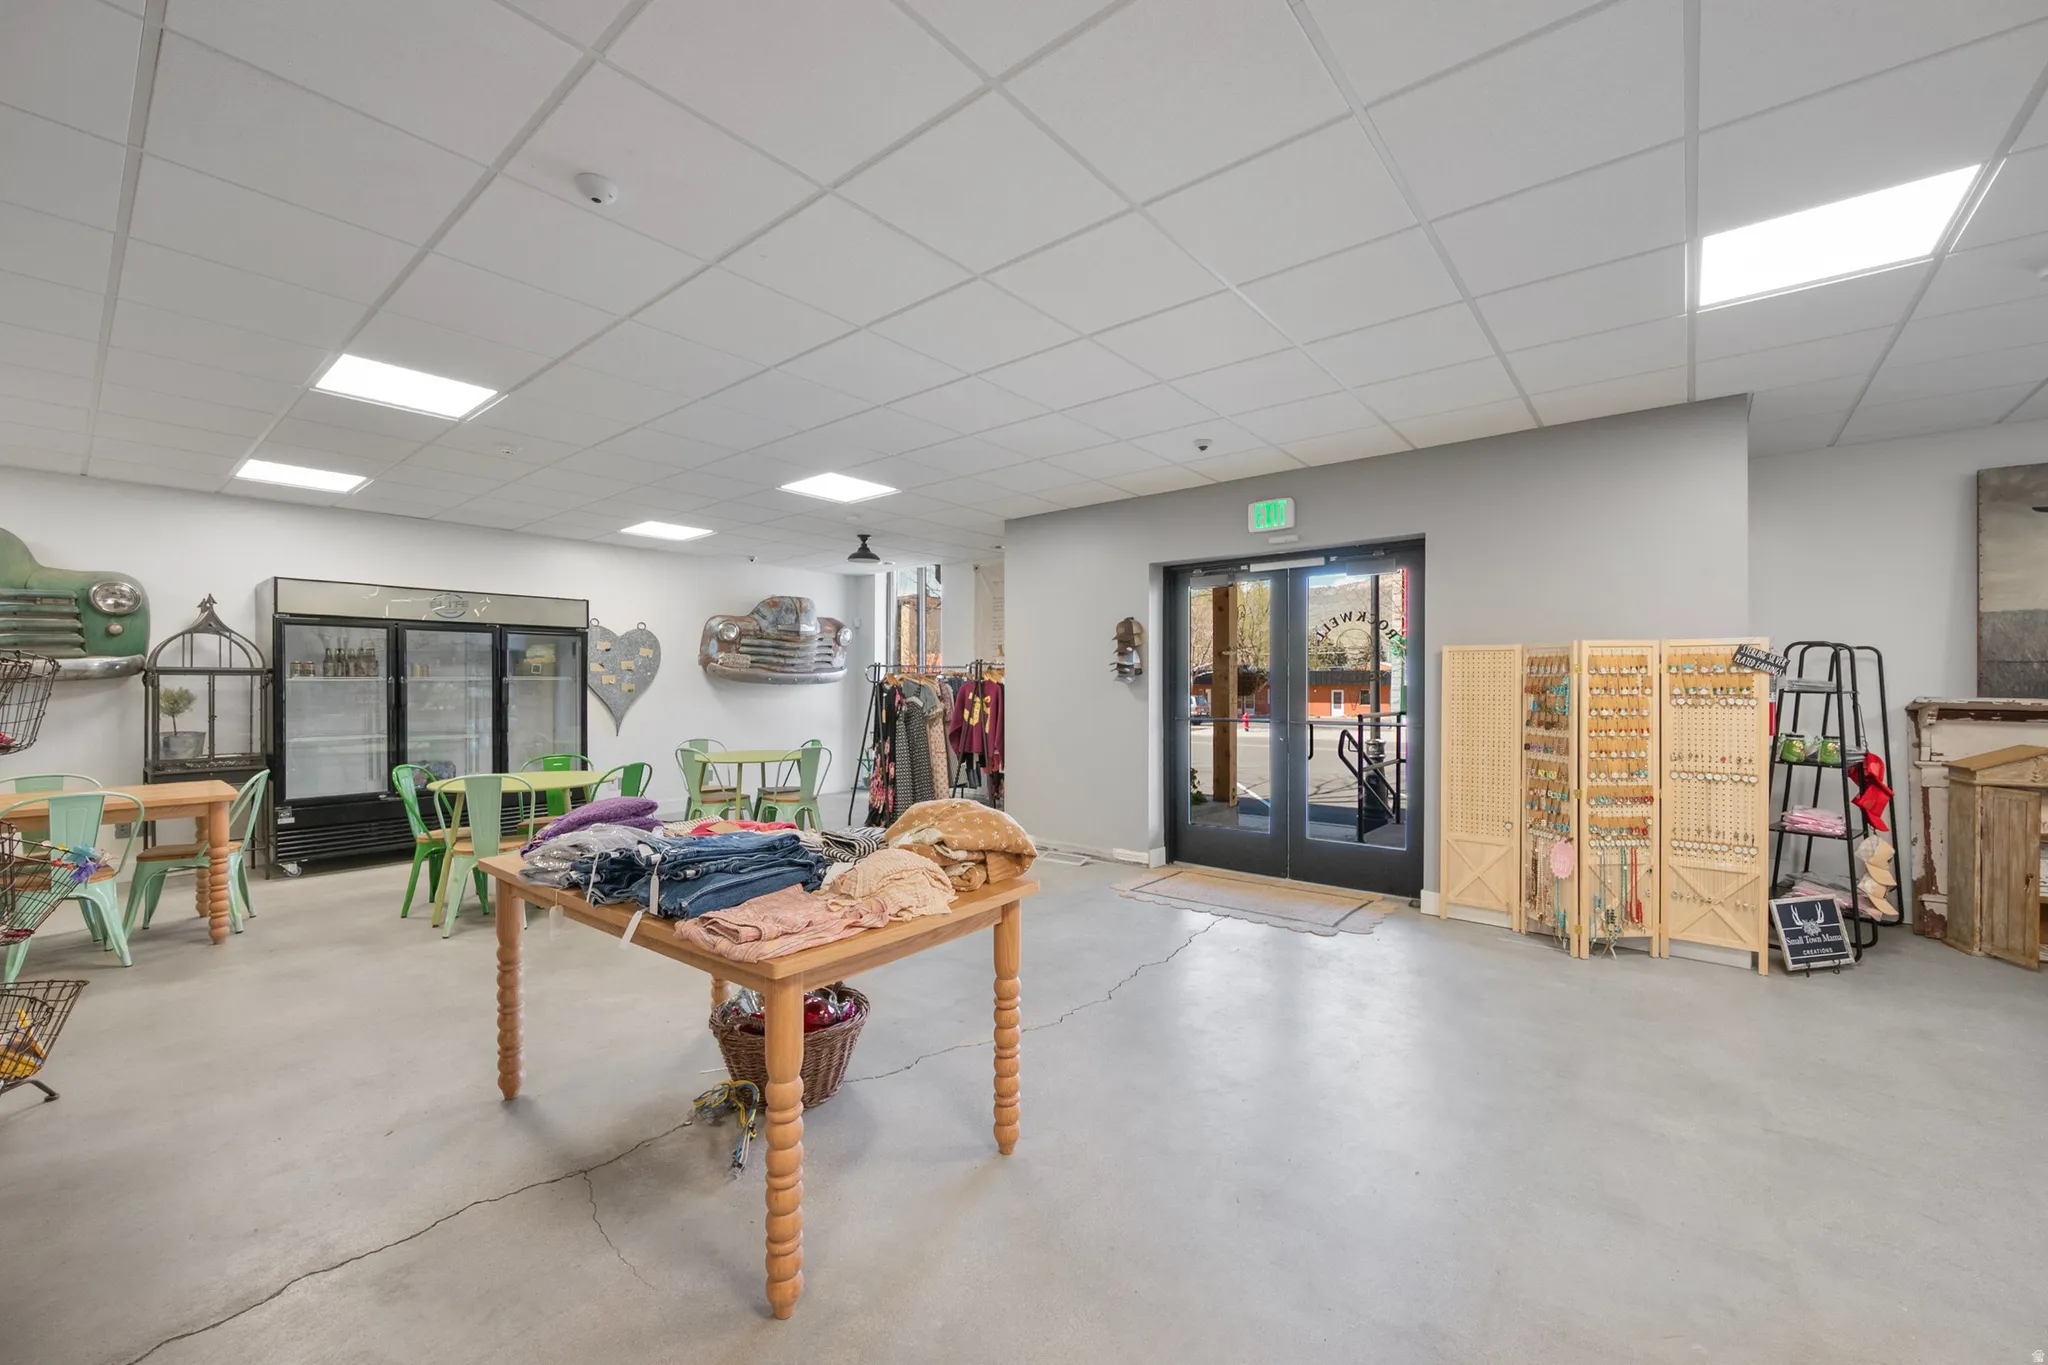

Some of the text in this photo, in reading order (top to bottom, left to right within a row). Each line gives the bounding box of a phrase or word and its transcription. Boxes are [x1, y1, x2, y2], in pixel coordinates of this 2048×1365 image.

[1255, 499, 1287, 529] EXIT
[1734, 654, 1784, 677] PLATED EARRINGS
[1741, 645, 1787, 667] STERLING SILVER
[1786, 933, 1843, 945] Small Town Mama
[1802, 947, 1833, 956] CREATIONS
